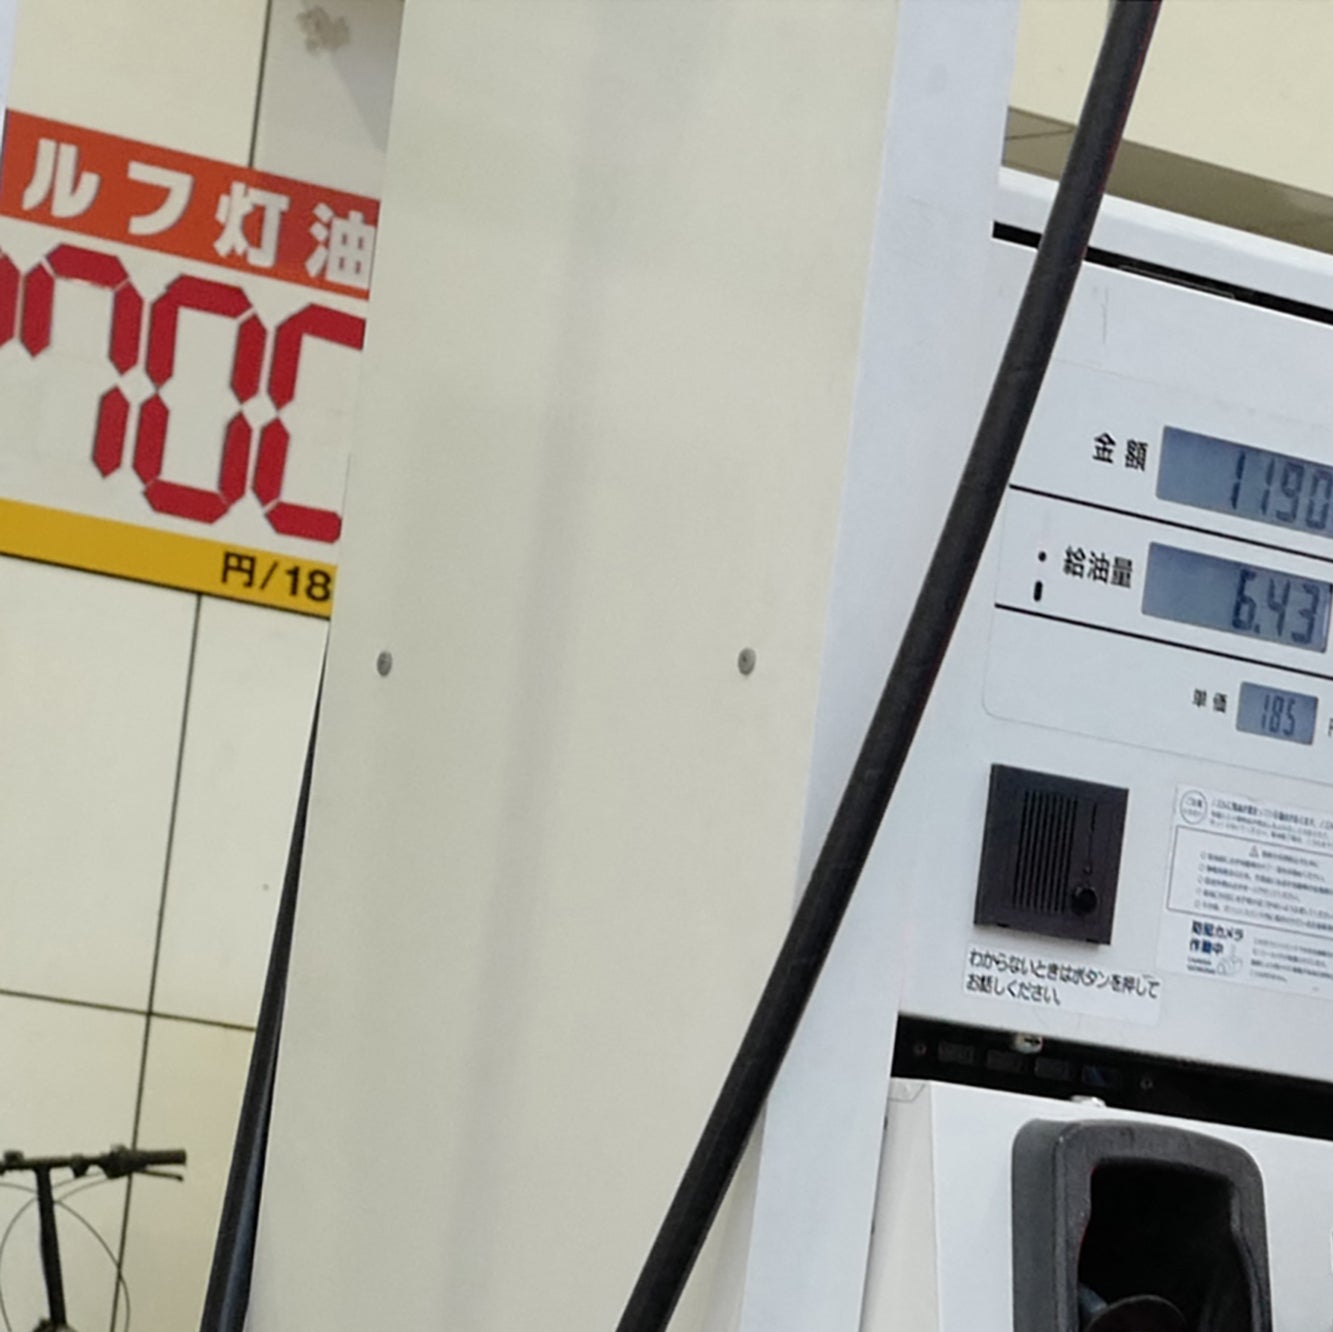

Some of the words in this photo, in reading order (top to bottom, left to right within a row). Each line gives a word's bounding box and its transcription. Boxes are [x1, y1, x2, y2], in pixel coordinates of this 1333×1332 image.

[21, 138, 377, 291] ルフ灯油
[1091, 431, 1150, 473] 金額
[1227, 450, 1333, 531] 1190
[1061, 544, 1134, 589] 給油量
[1230, 568, 1321, 648] 6.43
[1260, 693, 1297, 737] 185
[968, 948, 1161, 999] わからないときはボタンを押して
